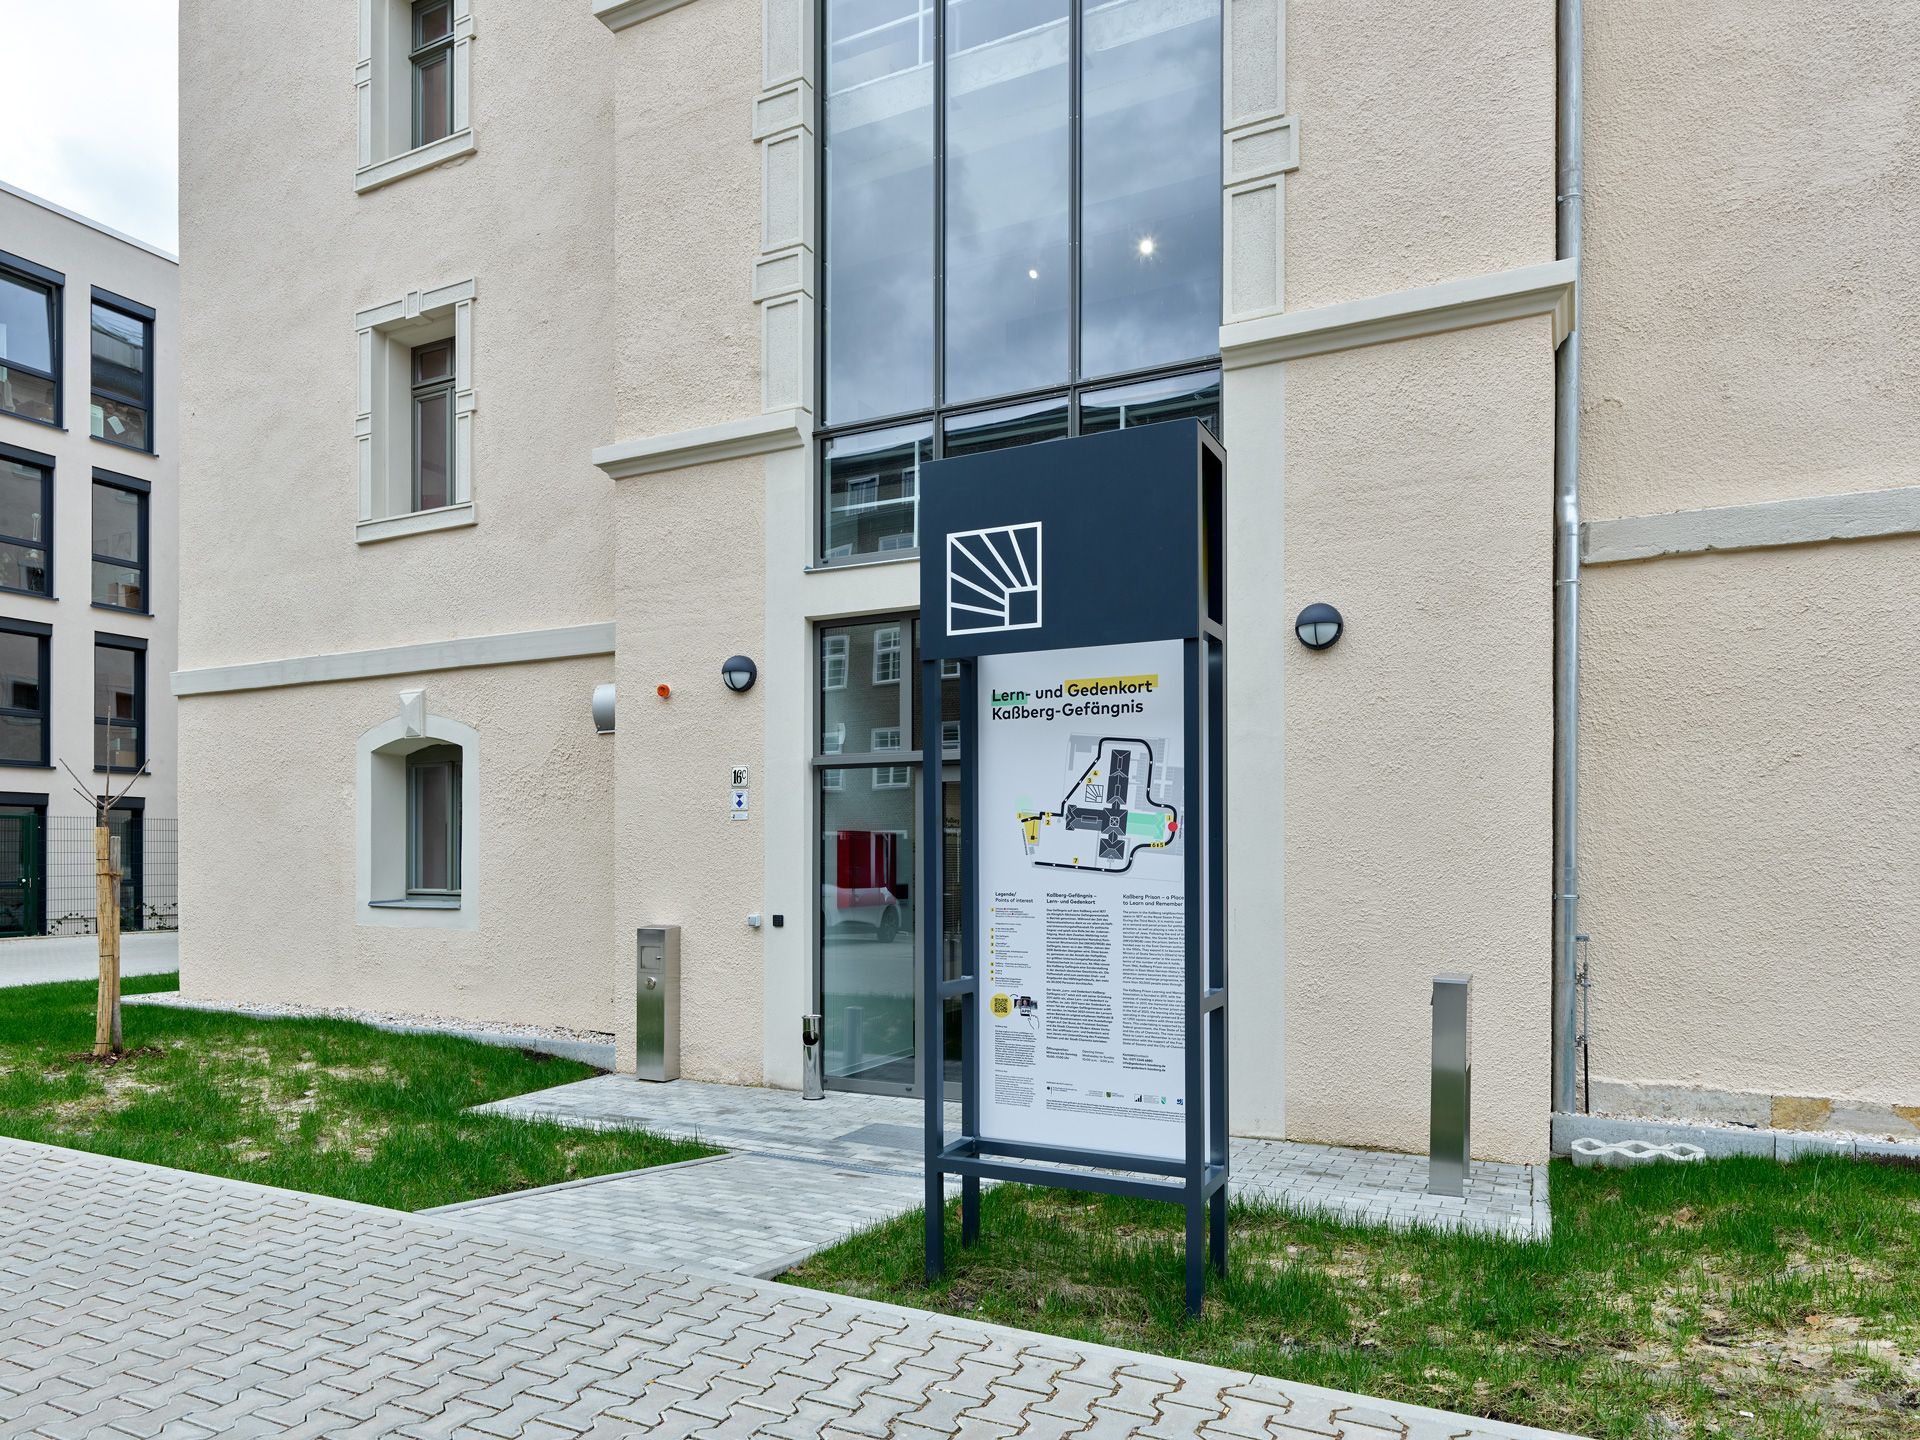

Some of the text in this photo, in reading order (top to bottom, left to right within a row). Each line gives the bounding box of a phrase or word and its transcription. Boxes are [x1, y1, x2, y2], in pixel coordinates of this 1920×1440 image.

[992, 680, 1153, 702] Lern- und Gedenkort
[992, 700, 1144, 720] Kaßberg-Gefängnis
